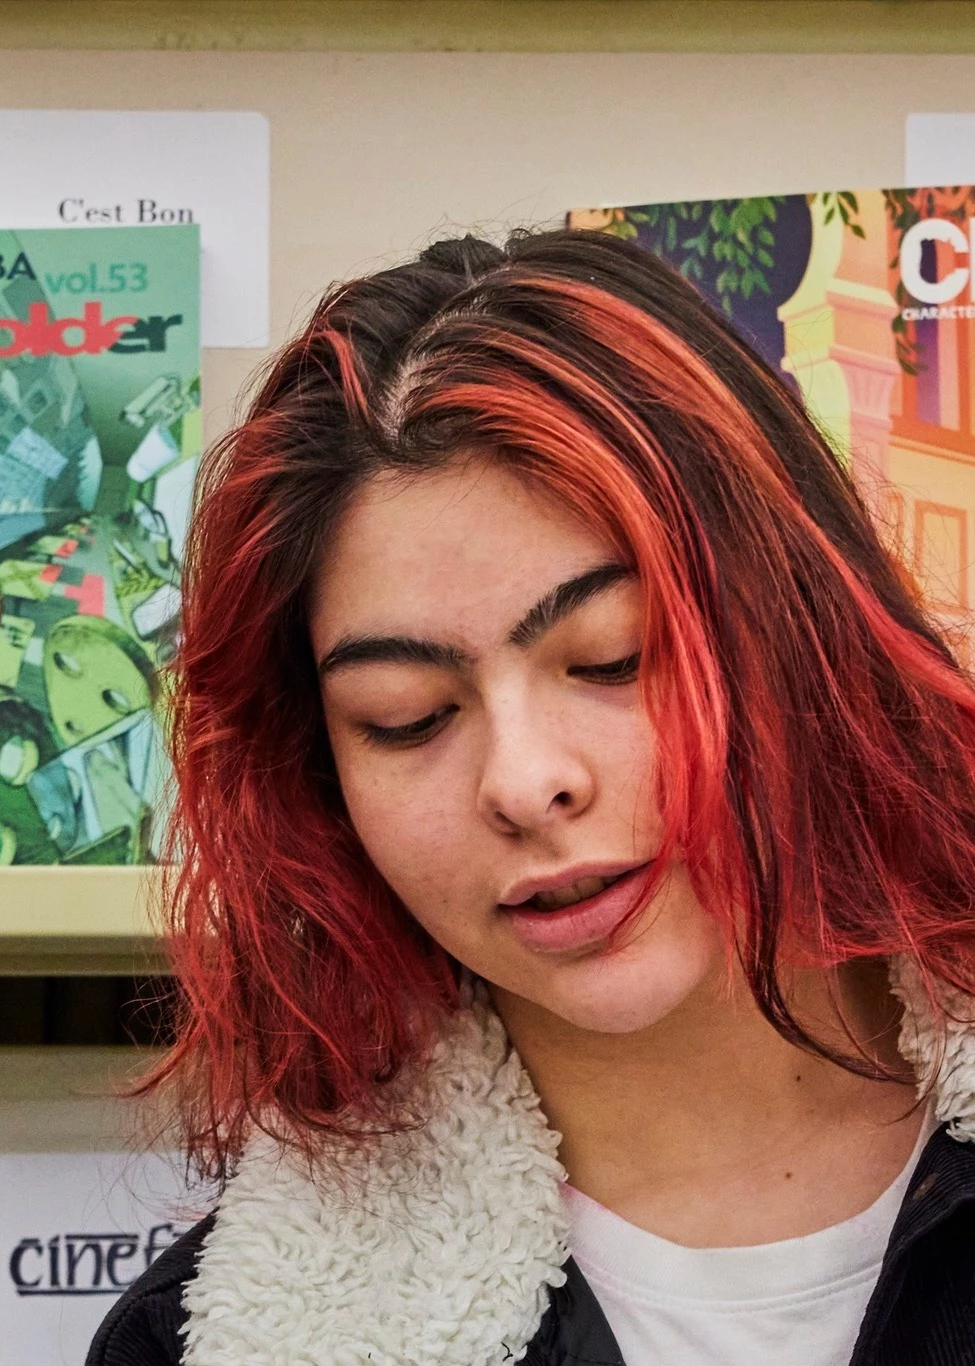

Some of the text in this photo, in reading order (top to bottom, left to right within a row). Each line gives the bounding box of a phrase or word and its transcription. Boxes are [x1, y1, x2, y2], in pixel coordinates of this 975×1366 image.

[58, 199, 194, 224] C'est Bon
[44, 262, 149, 295] vol.53
